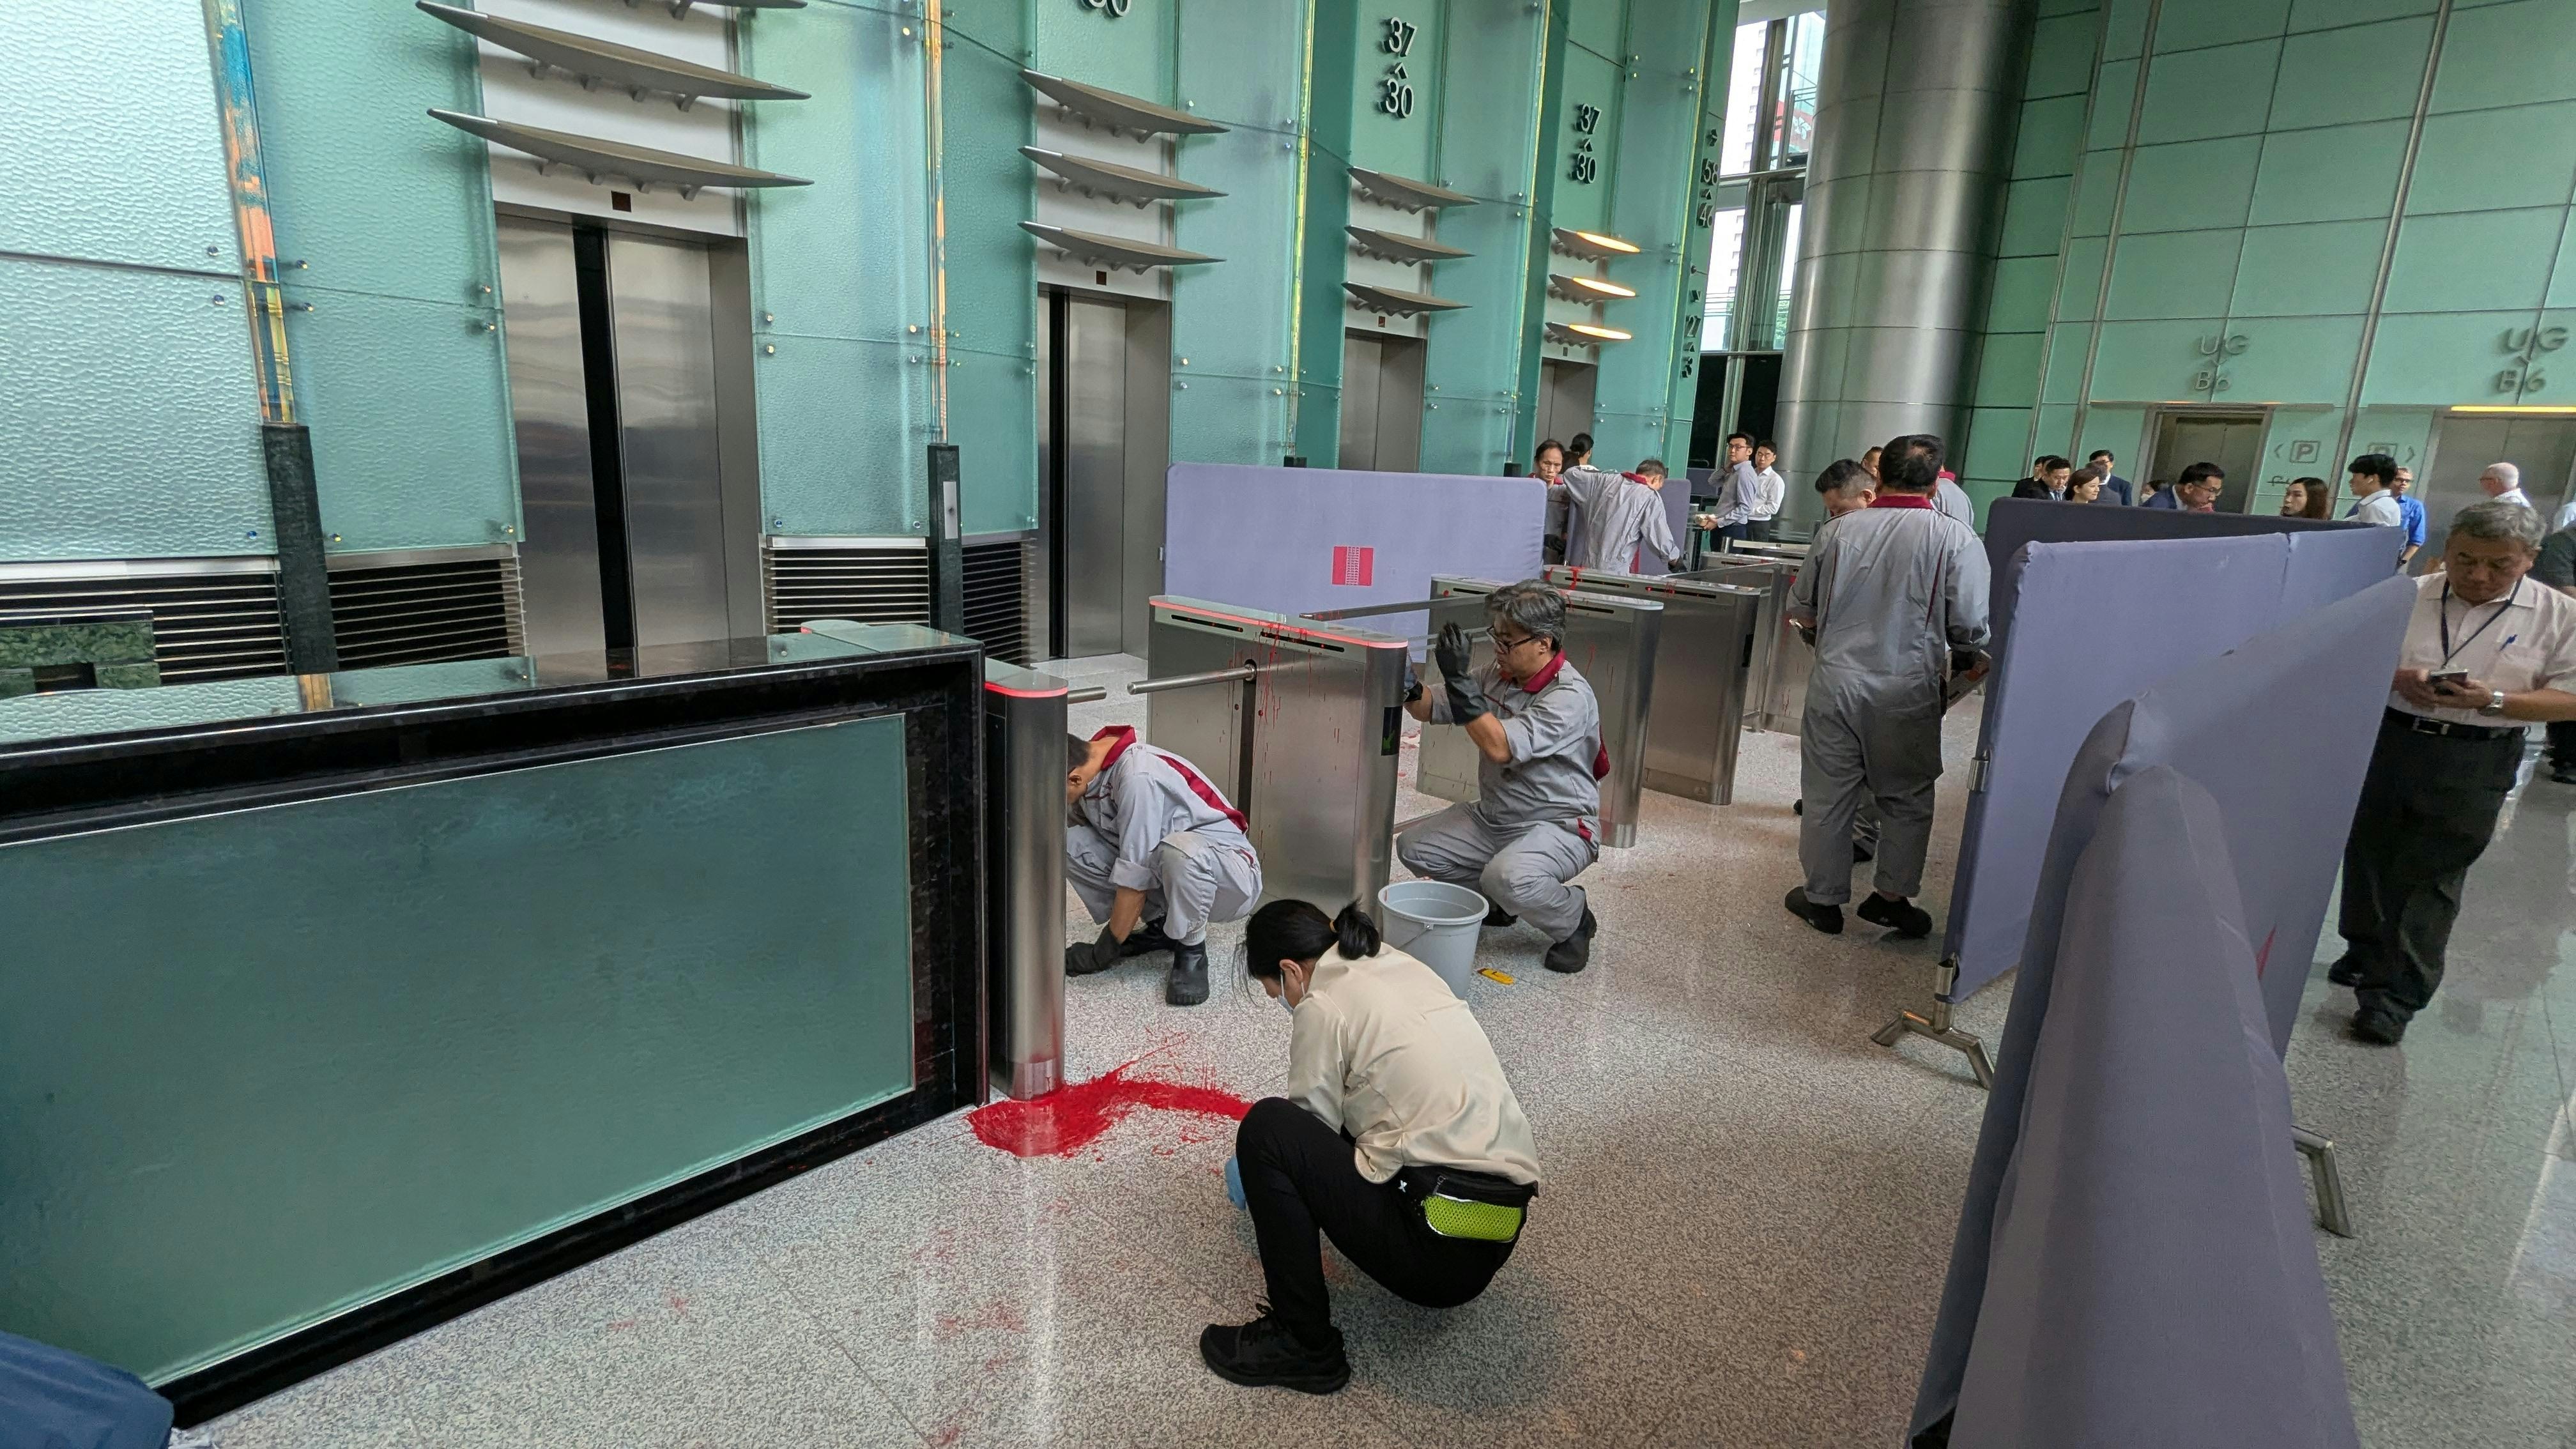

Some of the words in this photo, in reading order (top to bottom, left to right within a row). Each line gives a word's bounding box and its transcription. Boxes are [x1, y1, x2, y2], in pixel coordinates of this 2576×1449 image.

[1386, 17, 1418, 56] 37
[1384, 78, 1414, 118] 30
[1578, 103, 1602, 135] 37
[1574, 152, 1597, 184] 30
[1703, 158, 1719, 185] 58
[2200, 334, 2249, 355] UG
[2506, 326, 2568, 352] UG
[2195, 370, 2231, 391] B6
[2498, 369, 2546, 392] B6
[2296, 443, 2314, 461] P
